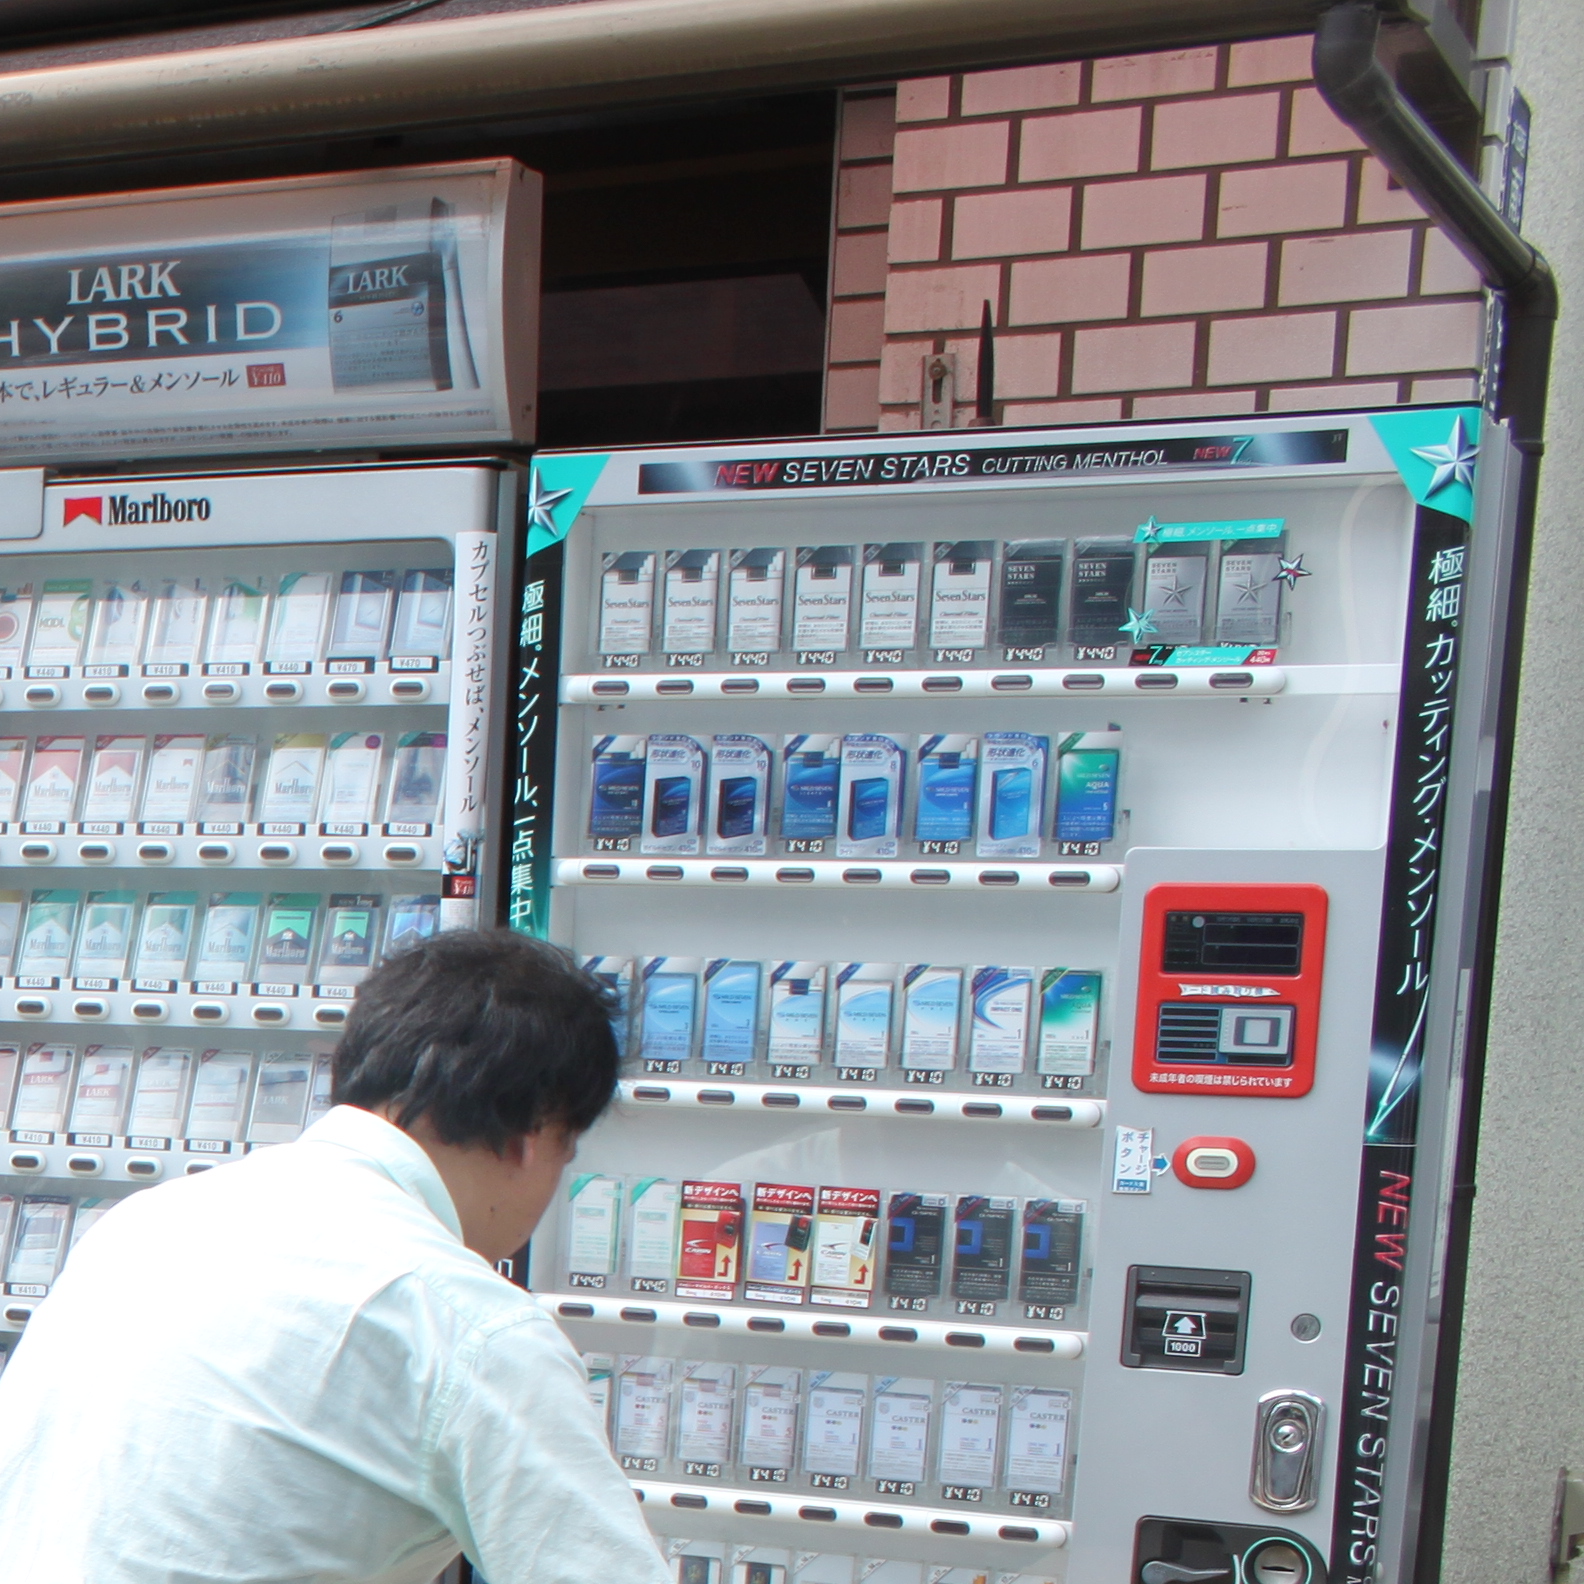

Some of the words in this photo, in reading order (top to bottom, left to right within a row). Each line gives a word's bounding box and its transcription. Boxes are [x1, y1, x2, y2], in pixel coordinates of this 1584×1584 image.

[67, 260, 181, 305] LARK
[347, 265, 410, 294] LARK
[715, 462, 779, 485] NEW
[783, 458, 873, 484] SEVEN
[880, 454, 971, 478] STARS
[981, 455, 1068, 474] CUTTING
[1073, 449, 1168, 469] MENTHOL
[1193, 446, 1231, 460] NEW
[107, 493, 212, 527] Marlboro
[459, 539, 491, 814] カプセルつぶせば、メンソール
[1397, 545, 1466, 996] 極細。カッティング・メンソール
[1149, 1072, 1293, 1088] 未成年者の喫煙は禁じられています
[1121, 1131, 1134, 1175] ボタン
[1137, 1131, 1149, 1176] チャージ
[684, 1185, 739, 1197] 新デザインへ
[756, 1187, 812, 1200] 新デザインへ
[821, 1189, 878, 1202] 新デザインへ
[1374, 1169, 1412, 1271] NEW
[891, 1297, 926, 1309] ¥410
[958, 1302, 993, 1315] ¥410
[1027, 1305, 1062, 1318] ¥410
[1170, 1342, 1195, 1353] 1000
[1361, 1281, 1400, 1420] SEVEN
[1349, 1433, 1386, 1566] STARS
